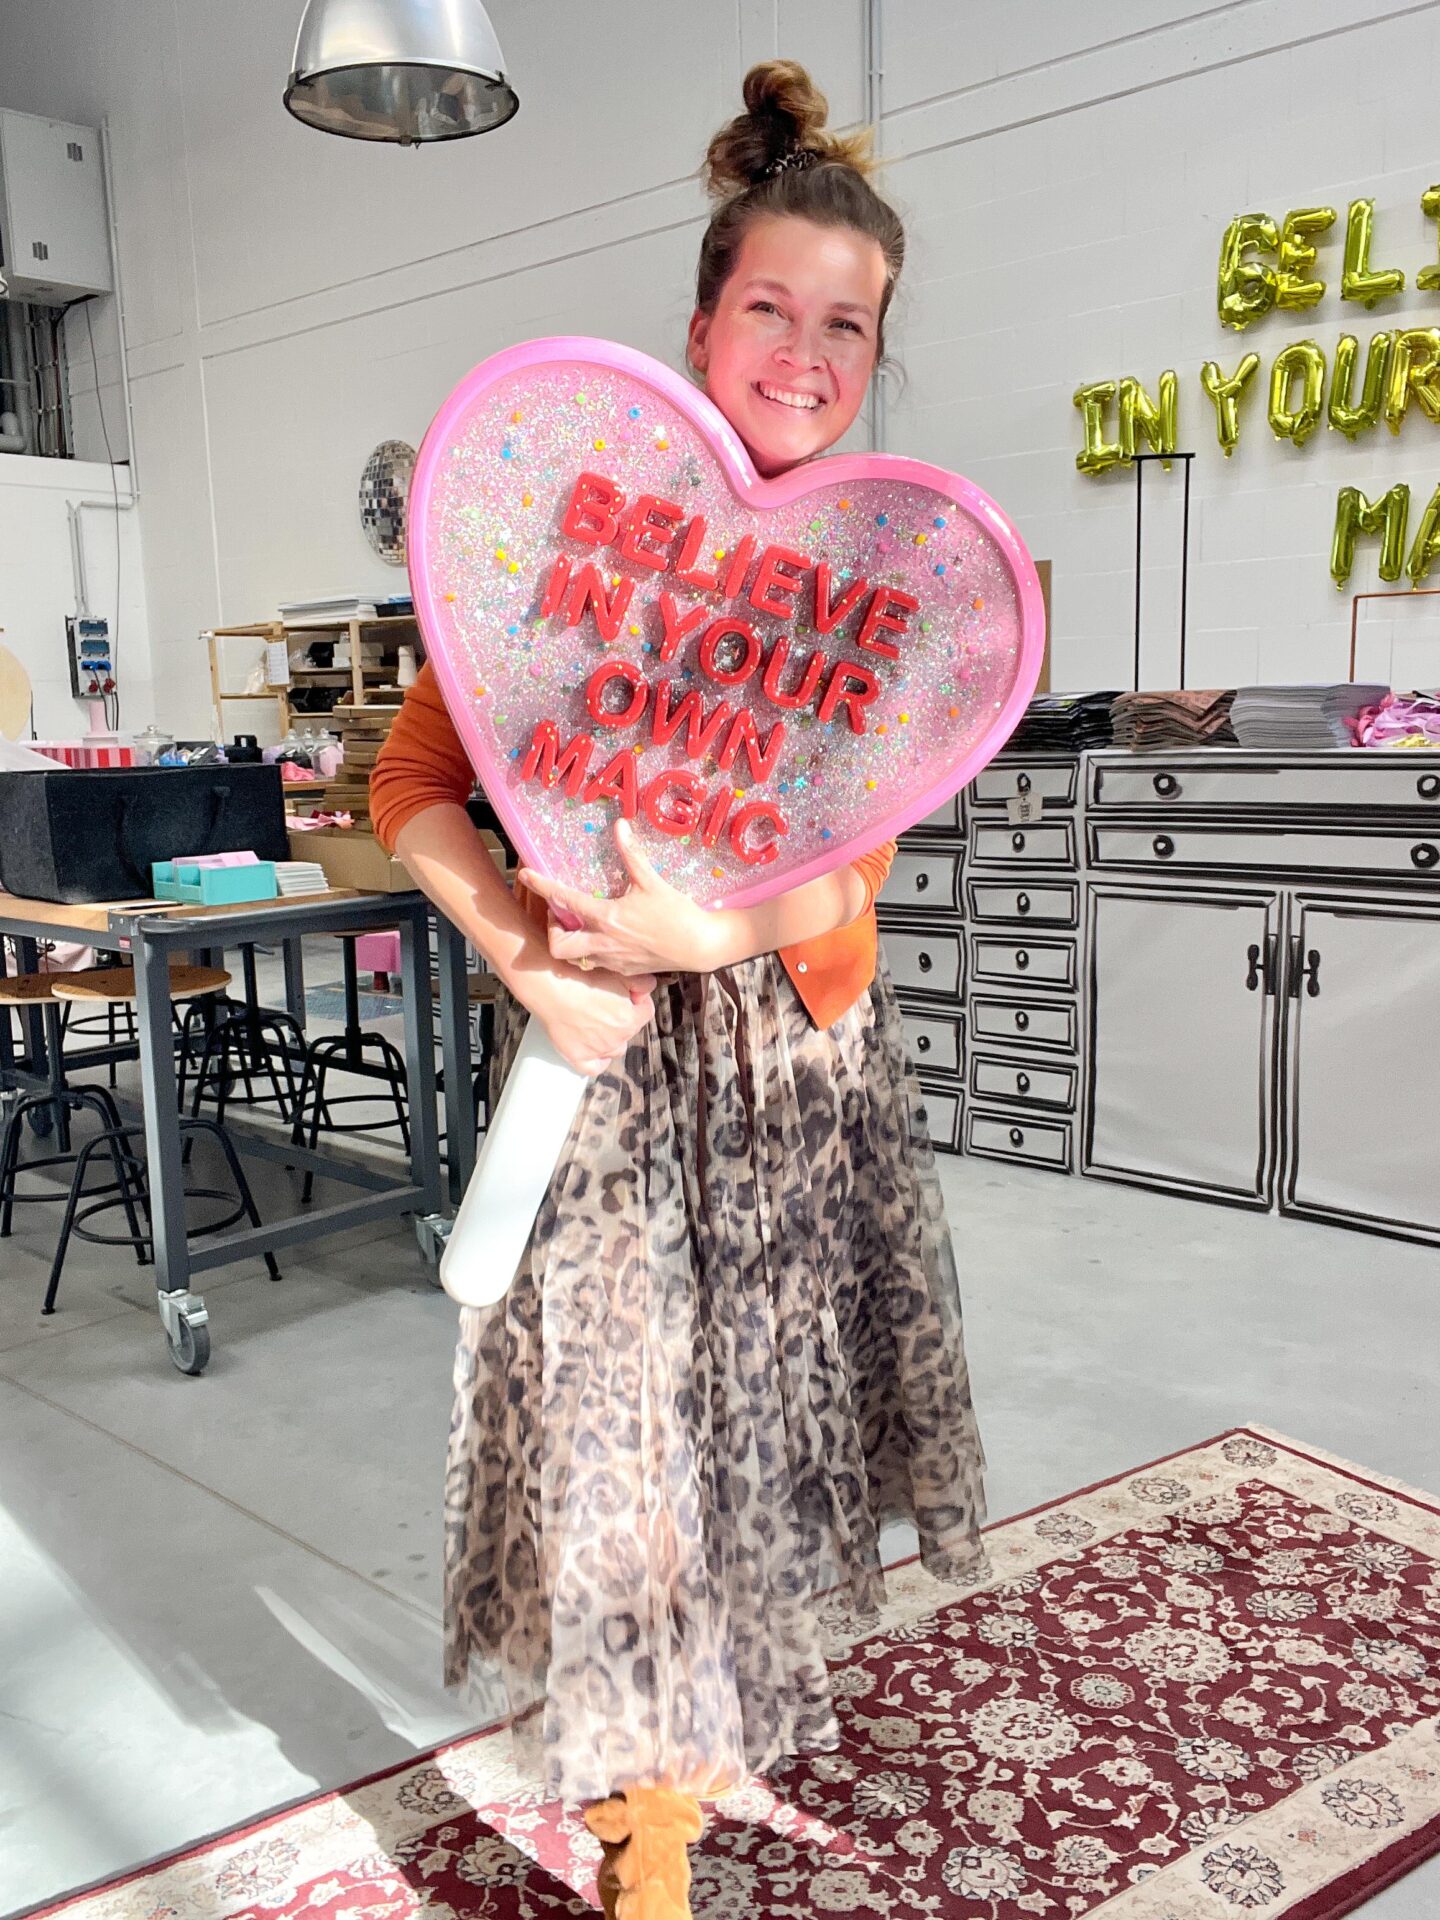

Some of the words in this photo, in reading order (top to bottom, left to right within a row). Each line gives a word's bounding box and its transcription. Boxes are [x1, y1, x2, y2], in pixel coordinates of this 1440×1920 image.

[1073, 369, 1178, 474] IN
[1200, 327, 1440, 458] YOUR
[562, 472, 920, 659] BELIEVE
[542, 555, 634, 641] IN
[659, 591, 881, 735] YOUR
[521, 720, 789, 865] MAGIC
[586, 661, 786, 783] OWN
